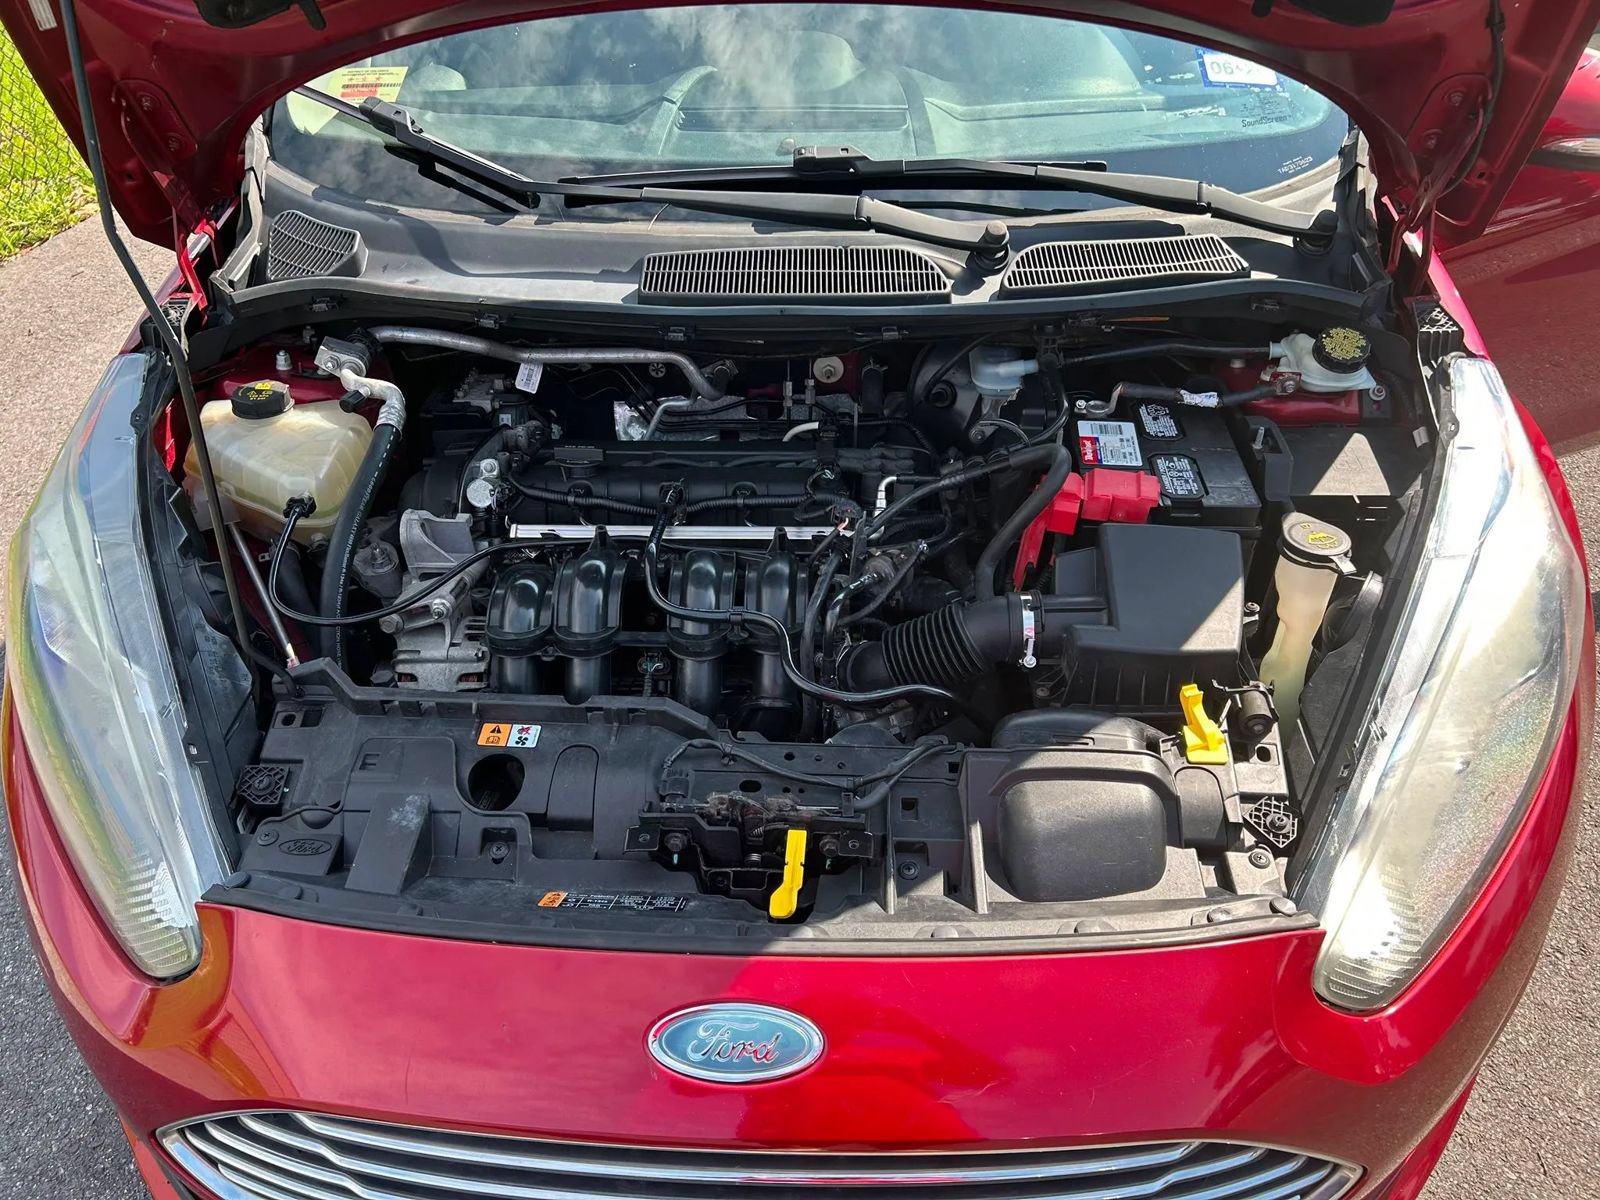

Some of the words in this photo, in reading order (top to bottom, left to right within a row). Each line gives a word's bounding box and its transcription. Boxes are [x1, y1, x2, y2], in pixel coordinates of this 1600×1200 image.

[1241, 114, 1288, 128] SoundScreen
[287, 840, 324, 853] Ford
[686, 1019, 782, 1063] Ford
